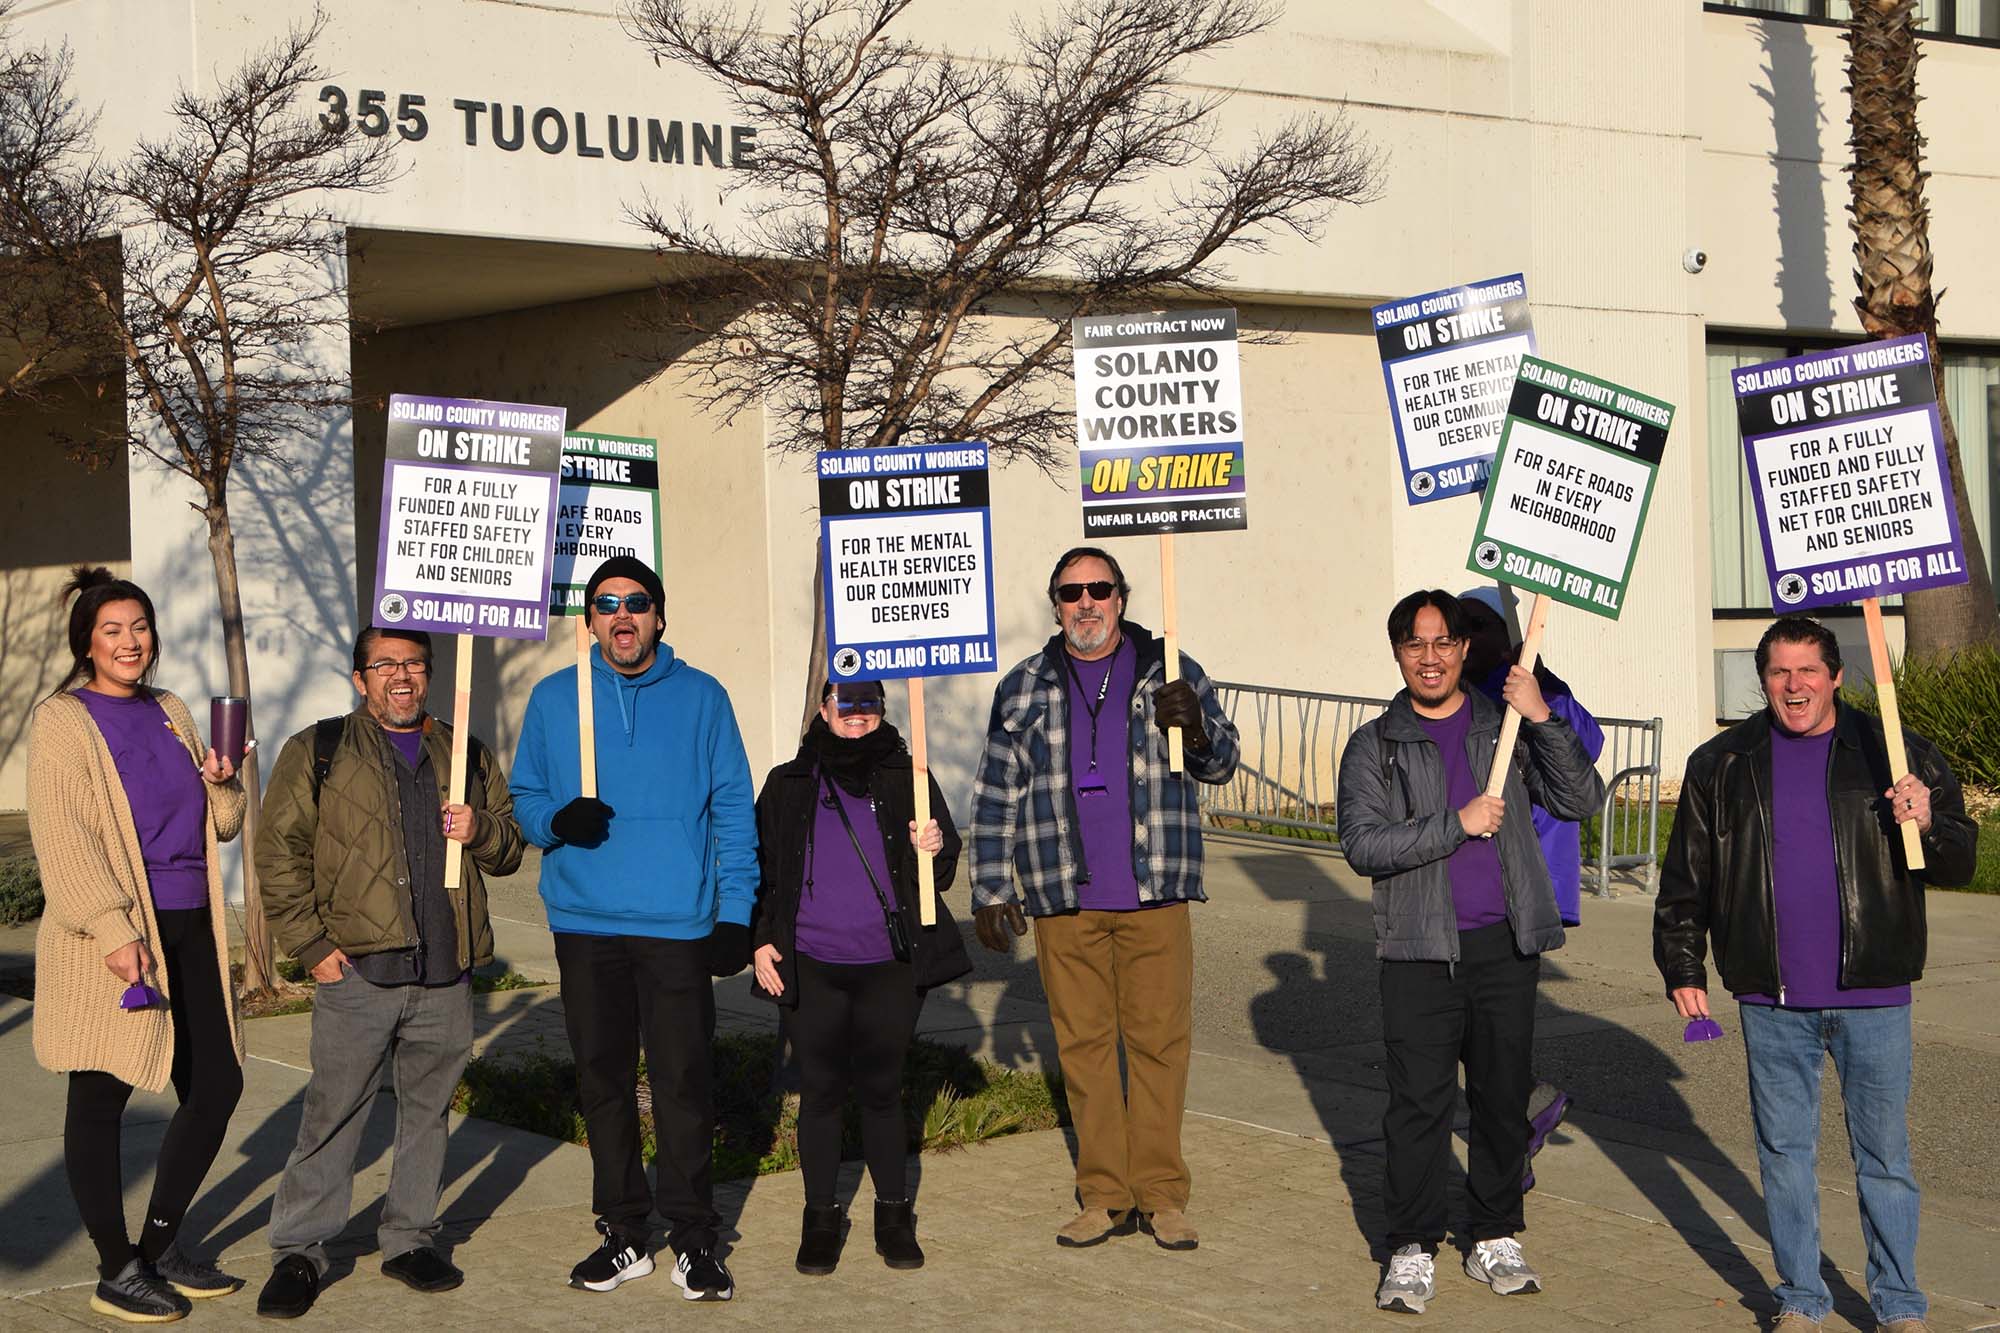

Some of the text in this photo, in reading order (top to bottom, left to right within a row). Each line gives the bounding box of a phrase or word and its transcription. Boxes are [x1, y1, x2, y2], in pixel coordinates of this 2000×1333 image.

[318, 85, 757, 169] 355 TUOLUMNE
[1376, 280, 1523, 326] SOLANO COUNTY WORKERS
[1085, 318, 1225, 338] FAIR CONTRACT NOW
[1403, 306, 1505, 351] ON STRIKE
[1095, 348, 1218, 377] SOLANO
[1403, 354, 1518, 392] FOR THE MENTAL
[1737, 342, 1924, 393] SOLANO COUNTY WORKERS
[1095, 379, 1220, 409] COUNTY
[1405, 388, 1457, 413] HEALTH
[1521, 362, 1670, 426] SOLANO COUNTY WORKERS
[1770, 374, 1900, 425] ON STRIKE
[393, 402, 560, 431] SOLANO COUNTY WORKERS
[1083, 411, 1237, 441] WORKERS
[1413, 398, 1508, 431] OUR COMMUN
[1537, 393, 1642, 451] ON STRIKE
[418, 428, 531, 465] ON STRIKE
[562, 437, 654, 458] UNTY WORKERS
[1438, 419, 1504, 446] DESERVE
[1790, 426, 1893, 461] FOR A FULLY
[561, 455, 631, 483] STRIKE
[821, 449, 984, 475] SOLANO COUNTY WORKERS
[1091, 452, 1234, 494] ON STRIKE
[1514, 448, 1634, 502] FOR SAFE ROADS
[1768, 444, 1925, 488] FUNDED AND FULLY
[425, 477, 517, 499] FOR A FULLY
[849, 475, 960, 509] ON STRIKE
[1536, 479, 1602, 514] IN EVERY
[1780, 469, 1922, 509] STAFFED SAFETY
[399, 497, 539, 523] FUNDED AND FULLY
[559, 505, 642, 524] AFE ROADS
[1088, 507, 1241, 527] UNFAIR LABOR PRACTICE
[1510, 494, 1616, 543] NEIGHBORHOOD
[1778, 491, 1933, 533] NET FOR CHILDREN
[404, 519, 531, 544] STAFFED SAFETY
[566, 524, 613, 540] EVERY
[842, 532, 972, 555] FOR THE MENTAL
[1806, 519, 1914, 552] AND SENIORS
[397, 541, 534, 566] NET FOR CHILDREN
[840, 555, 976, 578] HEALTH SERVICES
[416, 564, 512, 586] AND SENIORS
[1504, 553, 1562, 588] SOLANO
[1563, 572, 1592, 600] FOR
[1592, 584, 1618, 609] ALL
[1811, 564, 1882, 595] SOLANO
[1886, 556, 1922, 583] FOR
[1927, 551, 1961, 577] ALL
[847, 578, 971, 601] OUR COMMUNITY
[413, 599, 474, 624] SOLANO
[479, 605, 510, 626] FOR
[514, 607, 542, 629] ALL
[872, 602, 949, 623] DESERVES
[865, 647, 926, 670] SOLANO
[931, 644, 960, 665] FOR
[965, 642, 992, 663] ALL
